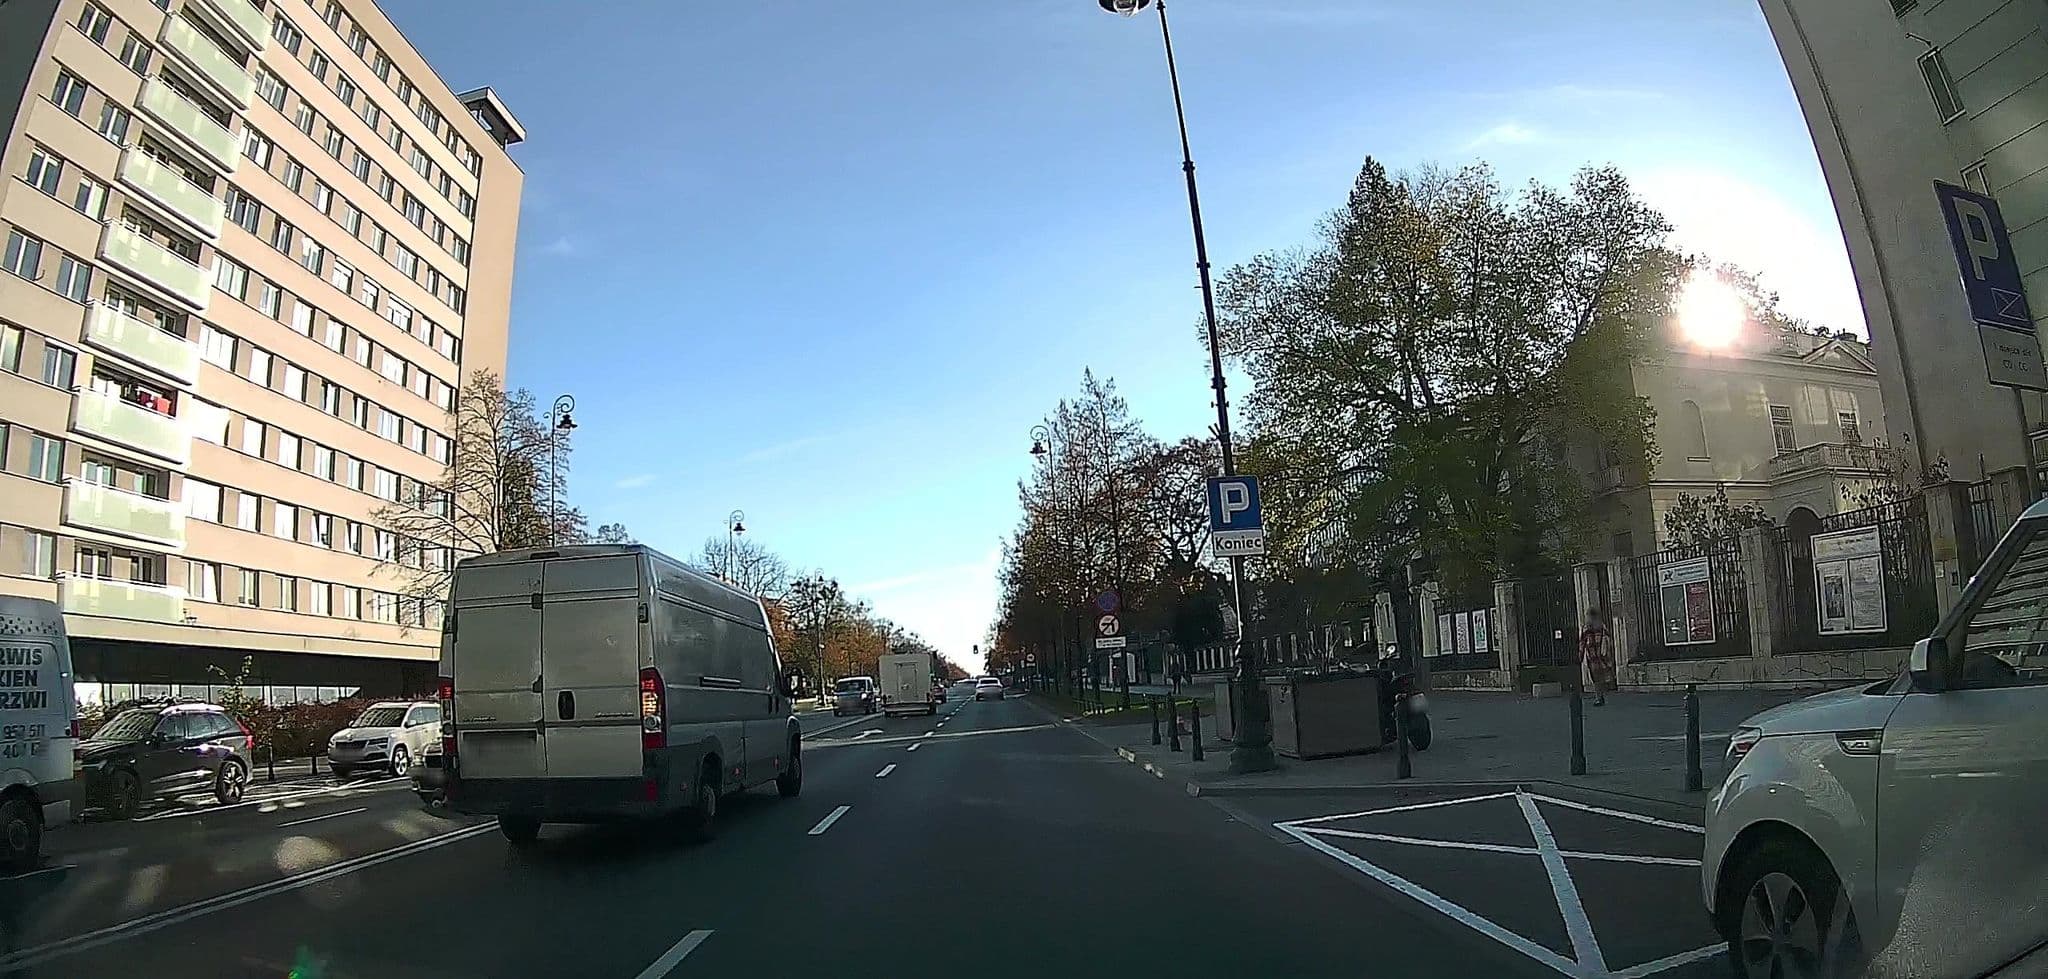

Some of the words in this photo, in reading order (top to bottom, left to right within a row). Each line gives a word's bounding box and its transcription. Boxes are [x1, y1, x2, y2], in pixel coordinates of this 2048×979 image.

[1952, 196, 1999, 281] P
[1219, 481, 1250, 524] P
[1215, 534, 1262, 550] Koniec
